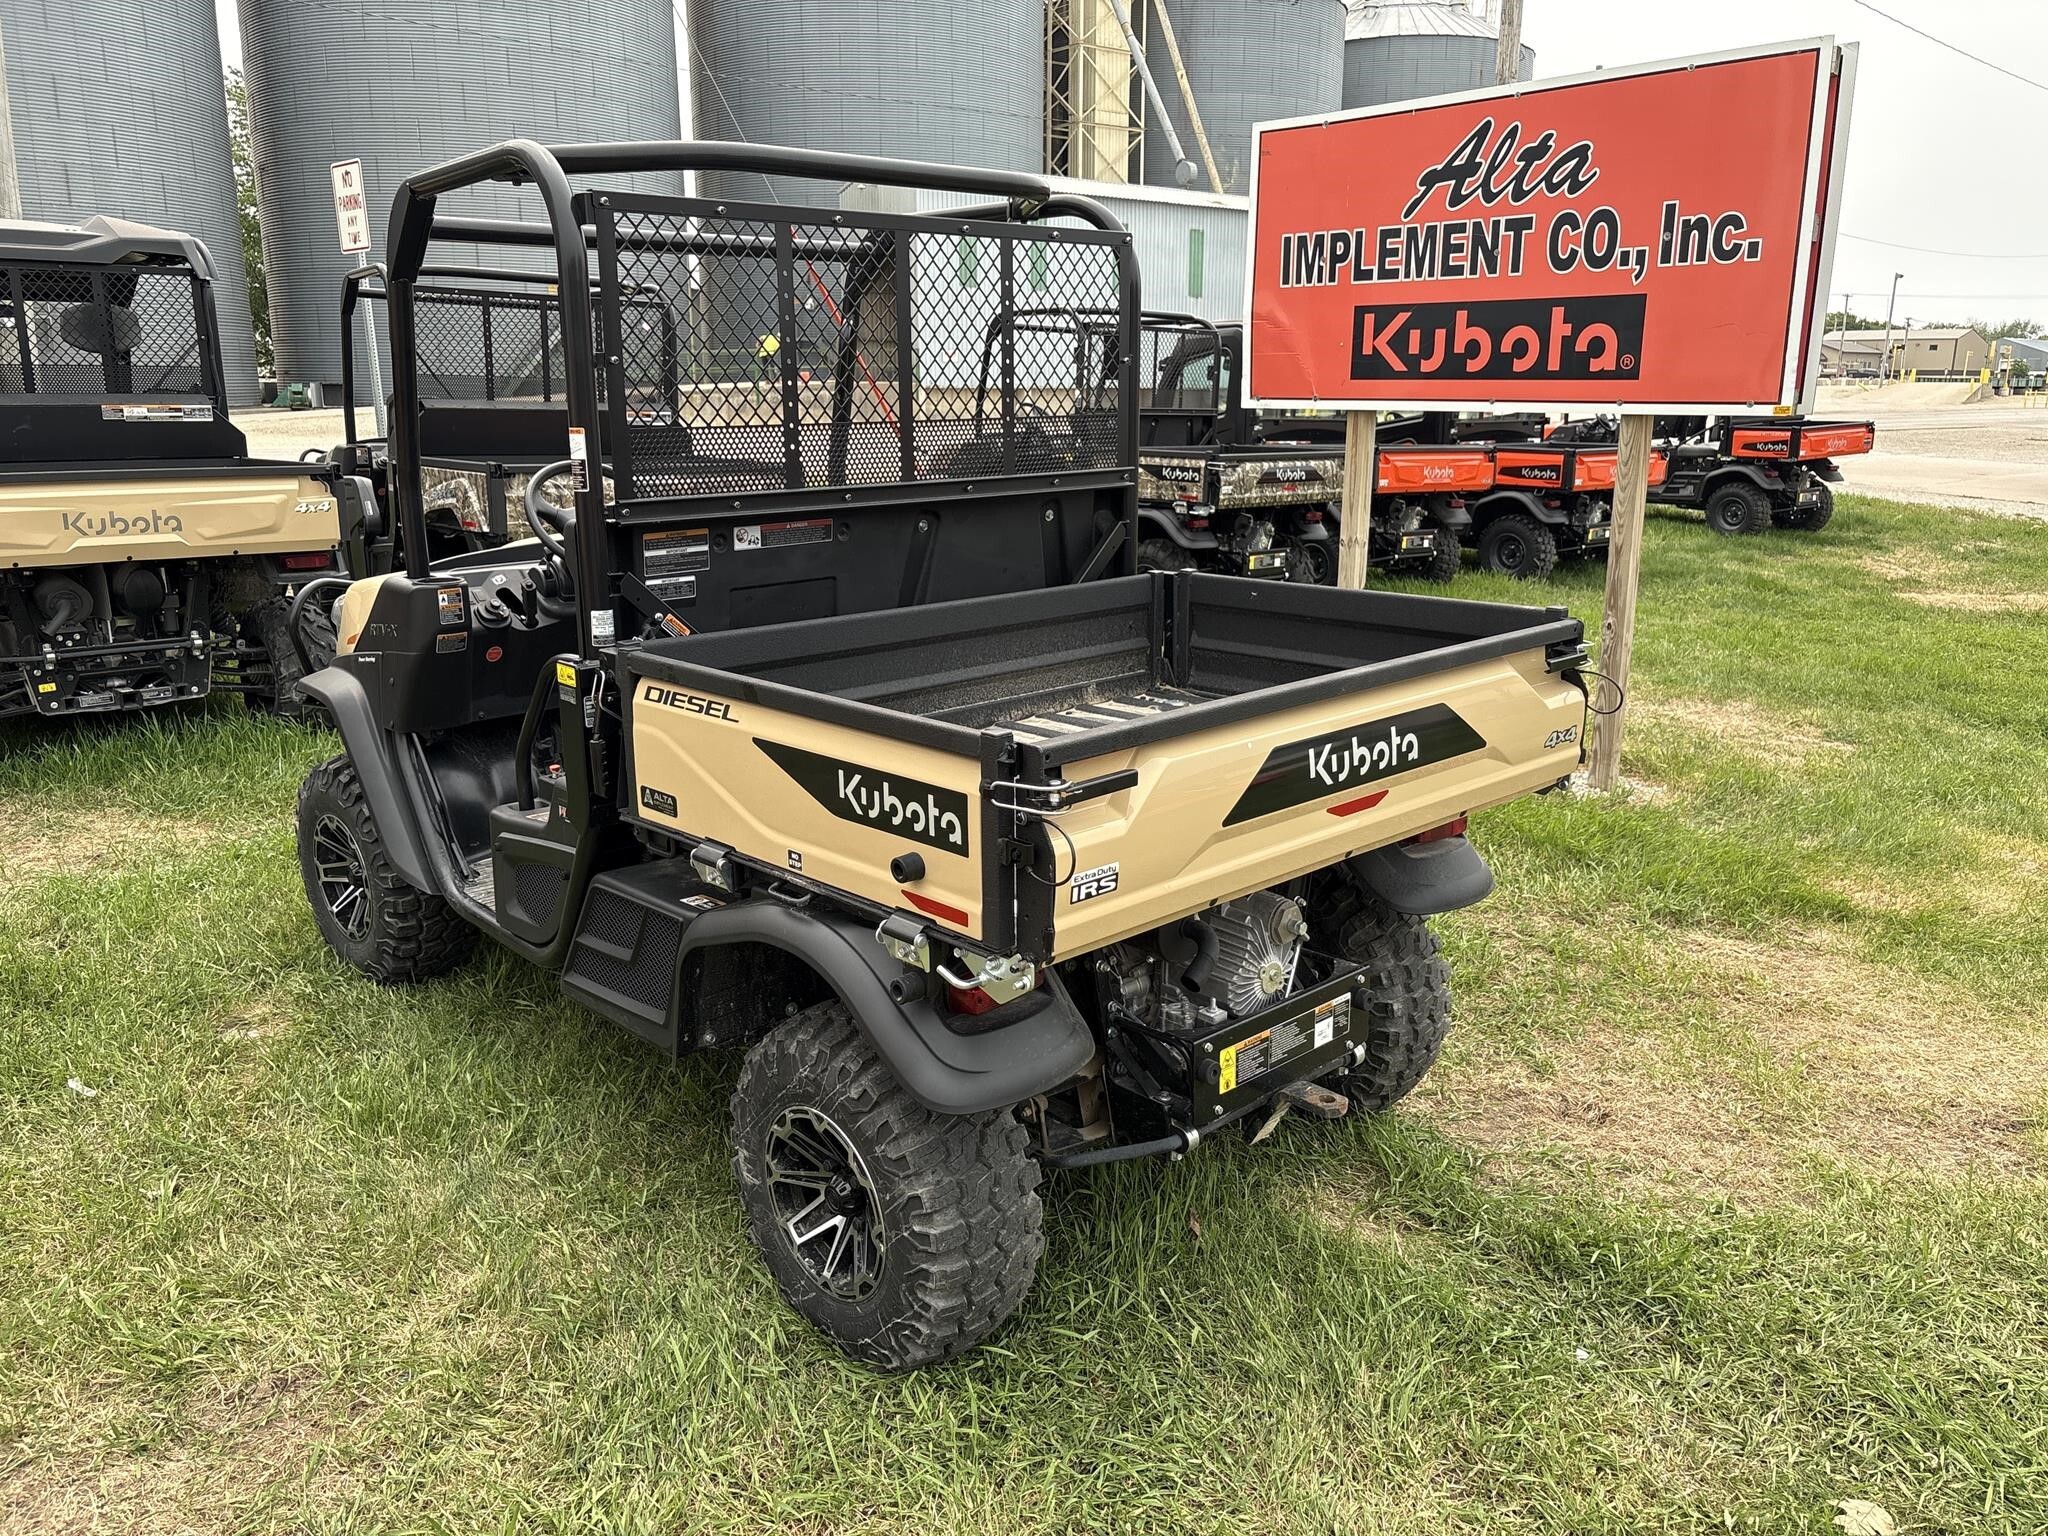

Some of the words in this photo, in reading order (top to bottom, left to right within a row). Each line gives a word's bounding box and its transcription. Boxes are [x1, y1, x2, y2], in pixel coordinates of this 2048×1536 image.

[1402, 117, 1600, 220] Alta
[341, 170, 353, 189] NO
[338, 193, 362, 212] PARKING
[347, 216, 358, 228] ANY
[1280, 215, 1536, 288] IMPLEMENT
[1547, 206, 1648, 285] CO.,
[1657, 201, 1763, 268] Inc.
[1362, 307, 1619, 373] Kubota
[1757, 442, 1788, 451] Kubota
[1162, 467, 1199, 482] Kubota
[1276, 468, 1306, 481] Kubota
[1423, 466, 1454, 479] Kubota
[1521, 467, 1556, 480] Kubota
[294, 501, 332, 514] 4x4
[62, 509, 183, 536] Kubota
[644, 685, 739, 723] DIESEL
[1544, 724, 1577, 749] 4x4
[1308, 726, 1418, 785] Kubota
[653, 792, 673, 806] ALTA
[838, 769, 962, 845] Kubota
[789, 859, 802, 868] STEP
[791, 852, 799, 861] NO
[1073, 871, 1096, 883] Extra
[1097, 865, 1117, 876] Duty
[1072, 874, 1117, 903] IRS
